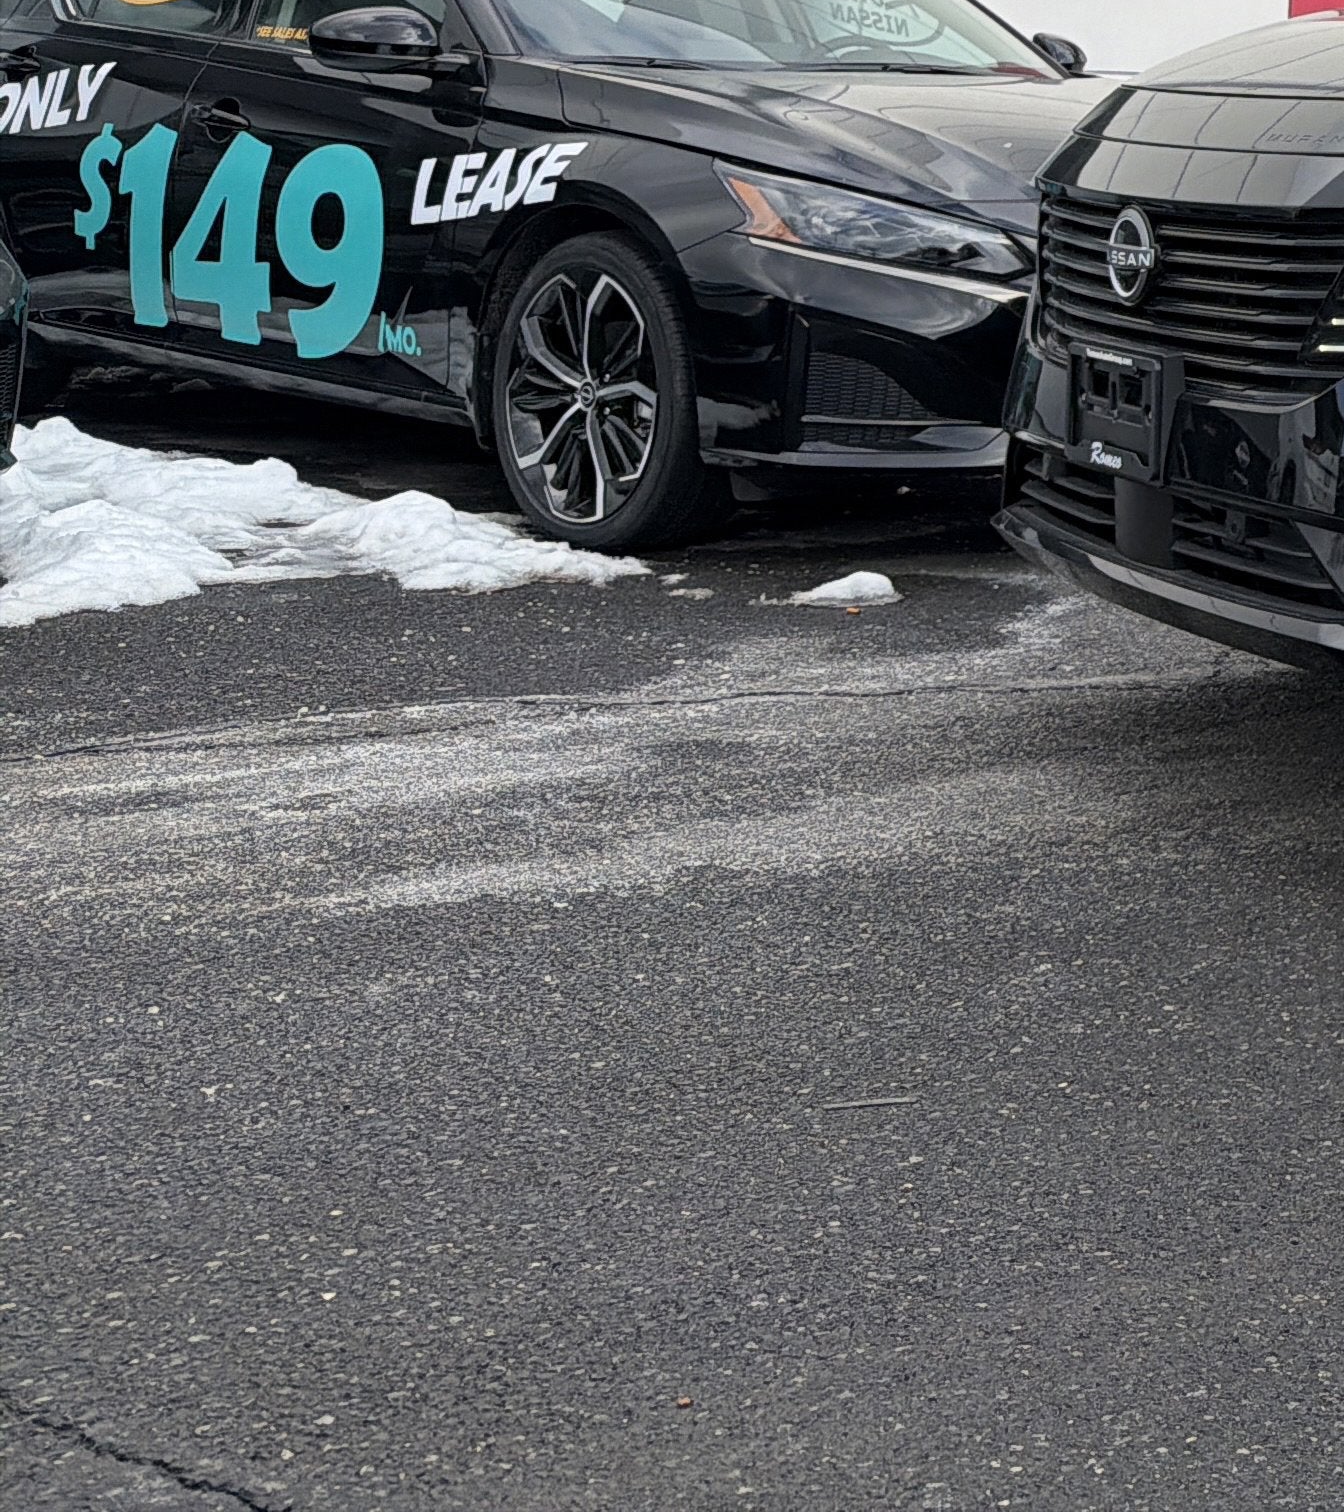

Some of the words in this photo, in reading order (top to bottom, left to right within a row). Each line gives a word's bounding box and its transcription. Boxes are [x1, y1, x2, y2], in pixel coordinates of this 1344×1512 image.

[0, 61, 118, 135] ONLY
[410, 141, 589, 226] LEASE
[73, 122, 385, 358] $149
[1110, 249, 1151, 267] SSAN
